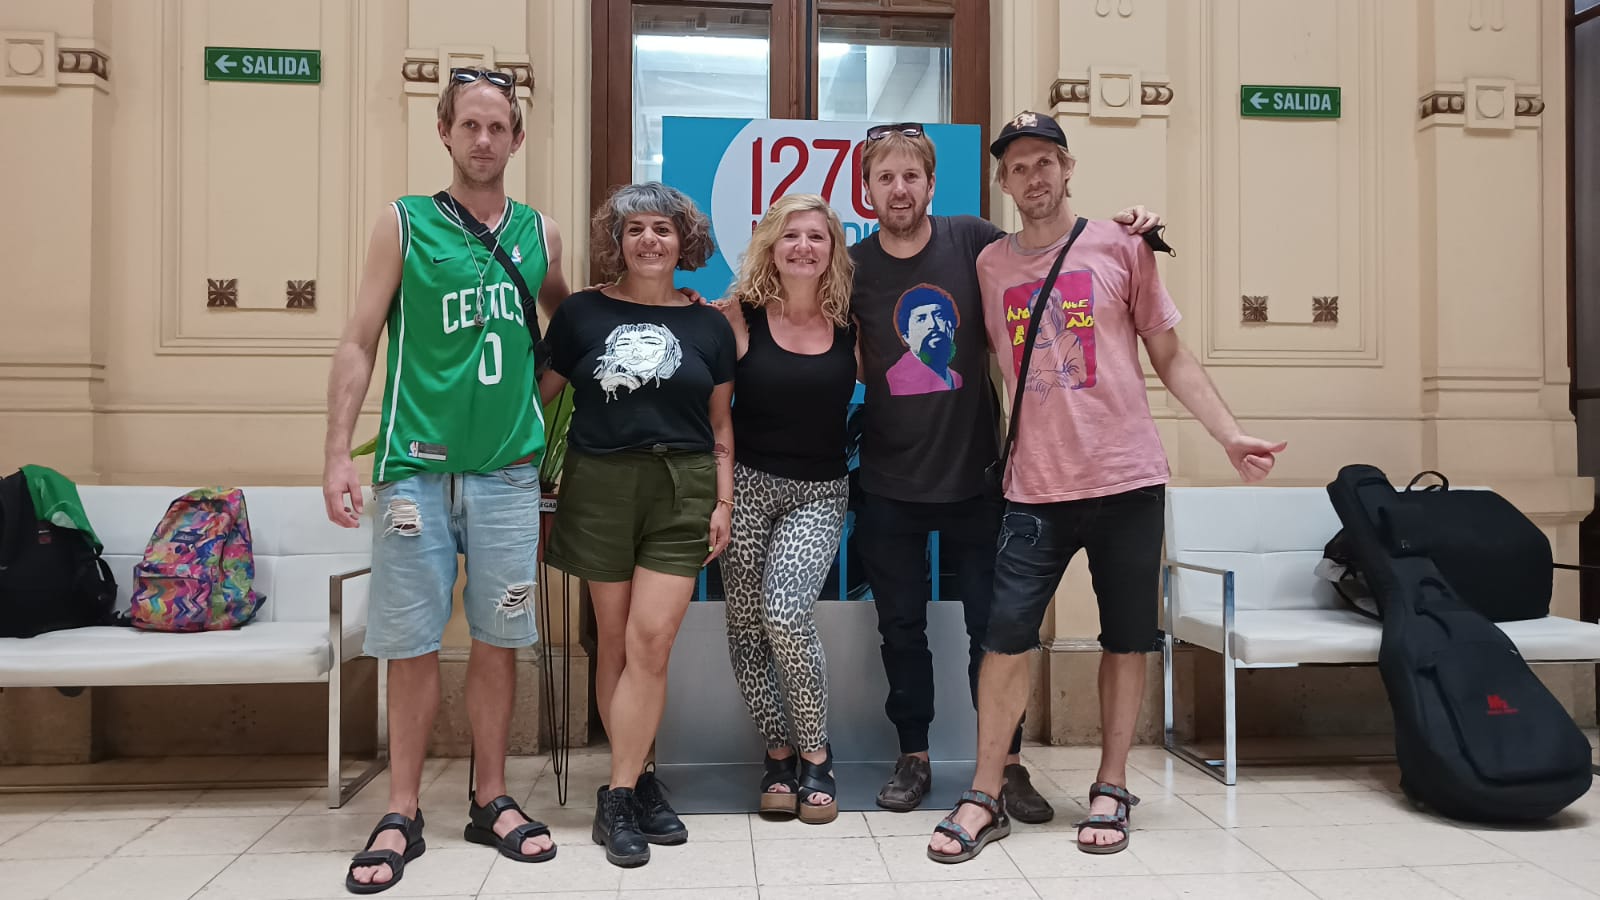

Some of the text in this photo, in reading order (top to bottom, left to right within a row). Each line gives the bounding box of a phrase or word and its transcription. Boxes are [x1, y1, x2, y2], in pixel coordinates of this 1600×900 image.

[242, 55, 311, 76] SALIDA
[1273, 92, 1332, 111] SALIDA
[478, 332, 503, 385] 0
